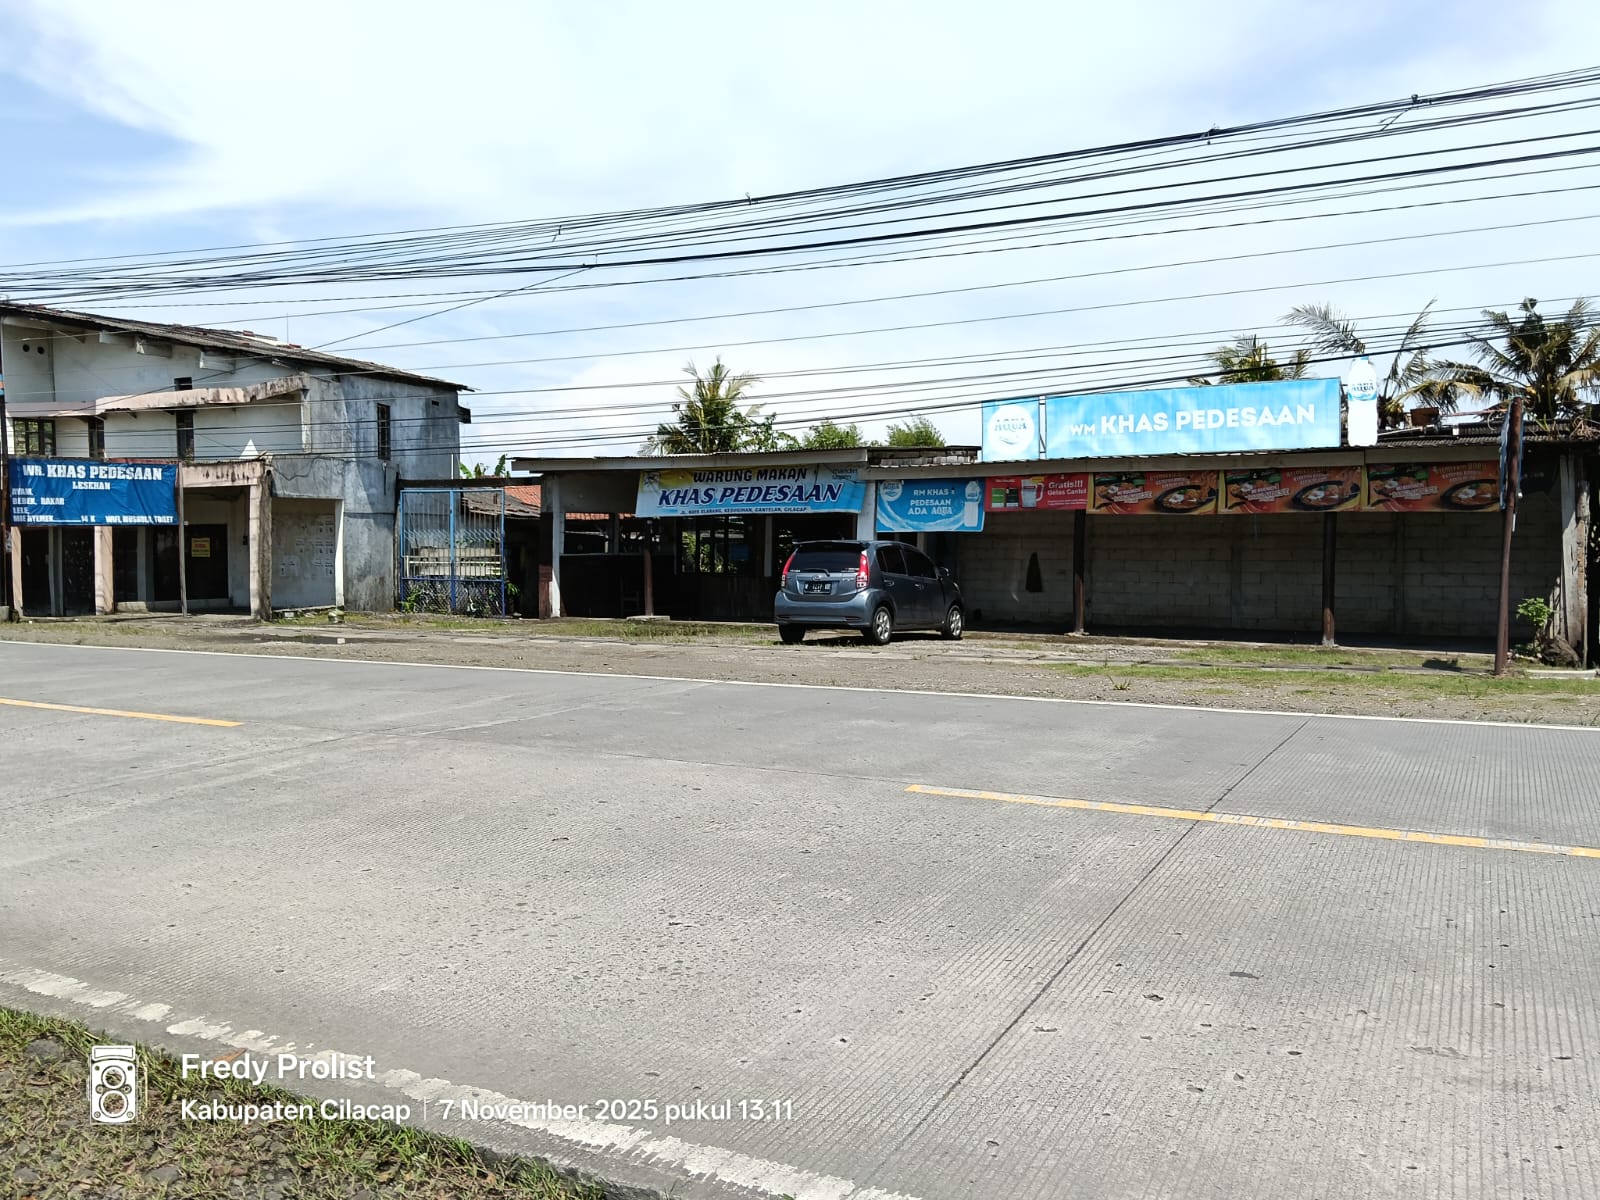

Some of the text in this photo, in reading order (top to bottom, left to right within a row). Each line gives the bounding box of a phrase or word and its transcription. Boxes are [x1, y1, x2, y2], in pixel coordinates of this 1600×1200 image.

[1071, 404, 1316, 438] WM KHAS PEDESAAN
[22, 464, 162, 480] WR. KHAS PEDESAAN
[693, 468, 807, 483] WARUNG MAKAN
[72, 481, 111, 490] LESEHAN
[658, 483, 844, 506] KHAS PEDESAAN
[926, 488, 949, 496] KHAS
[910, 499, 951, 507] PEDESAAN
[907, 507, 927, 515] ADA
